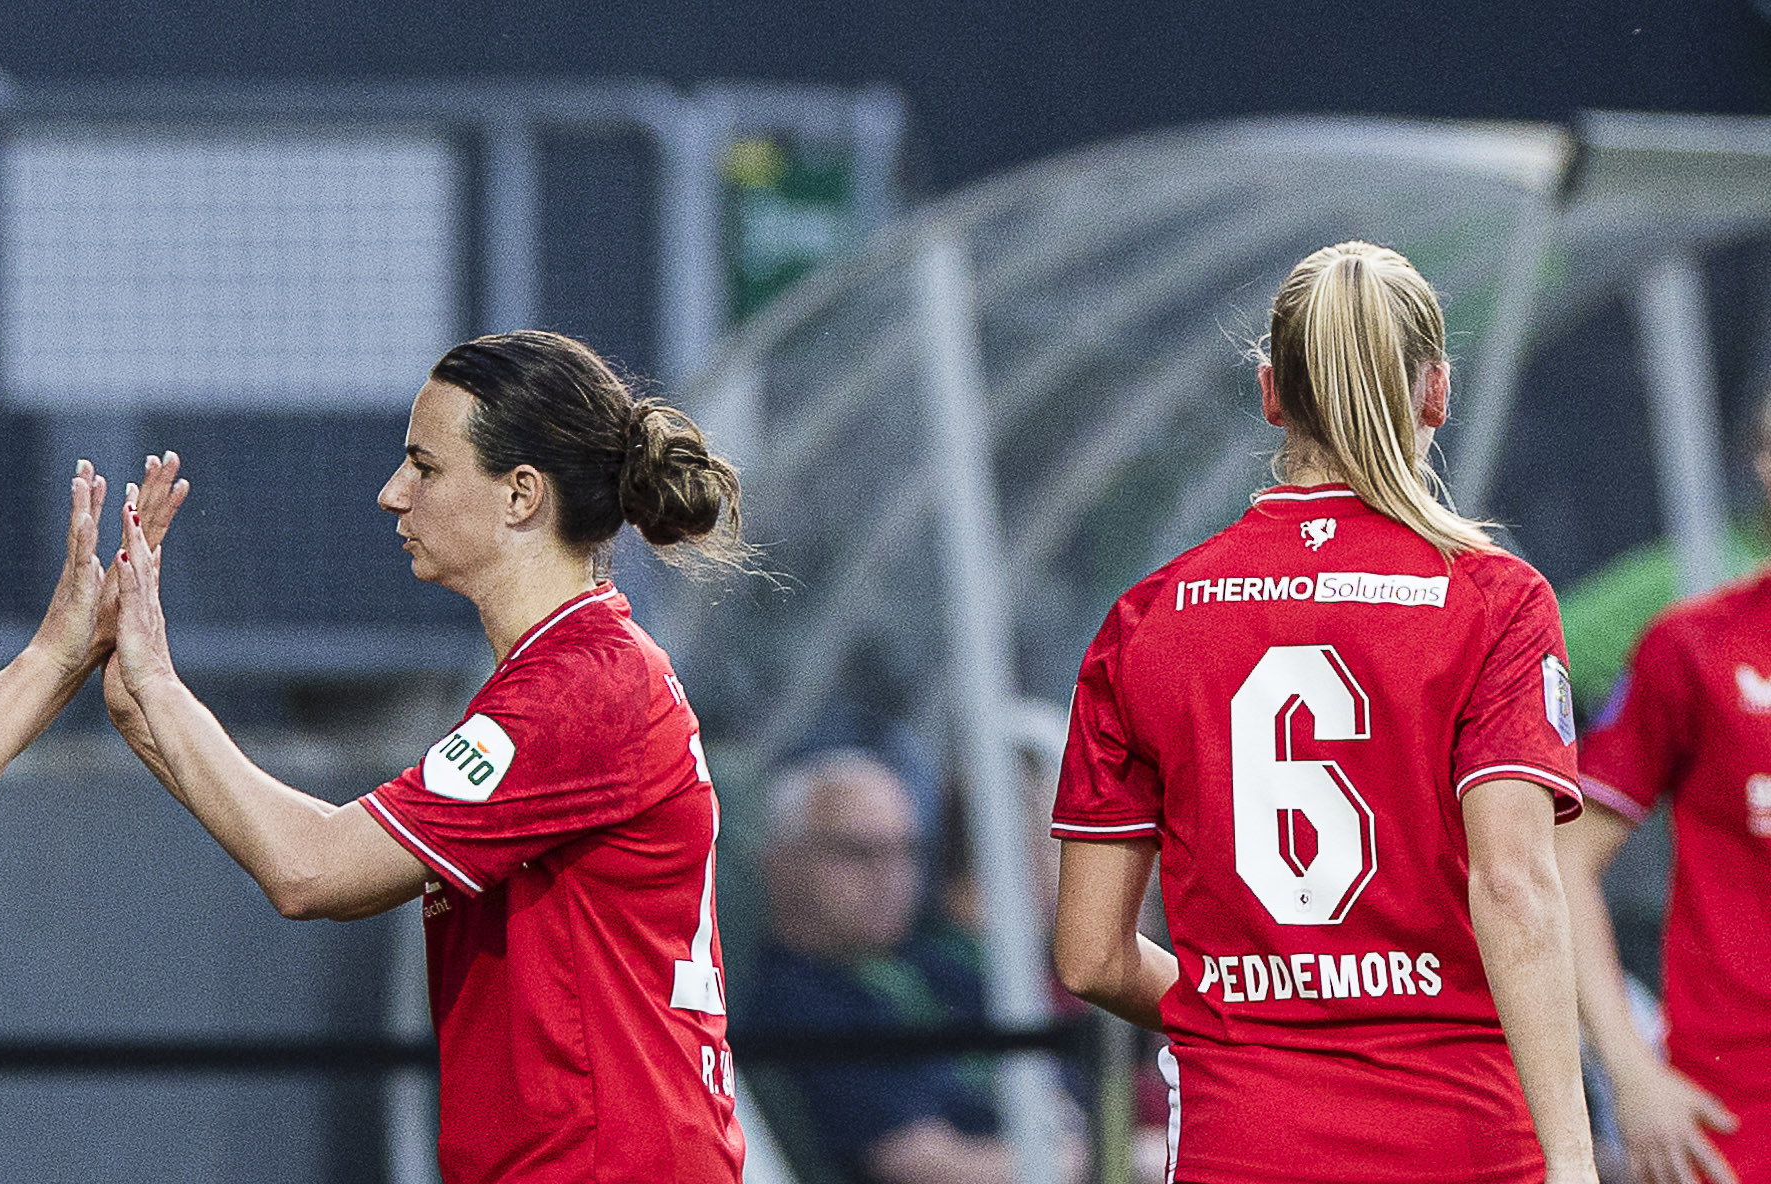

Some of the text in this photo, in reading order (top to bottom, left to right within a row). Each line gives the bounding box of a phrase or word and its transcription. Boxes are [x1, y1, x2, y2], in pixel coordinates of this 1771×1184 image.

[1321, 577, 1441, 603] Solutions
[439, 733, 494, 786] TOTO
[1231, 645, 1377, 925] 6
[1197, 951, 1442, 1002] PEDDEMORS
